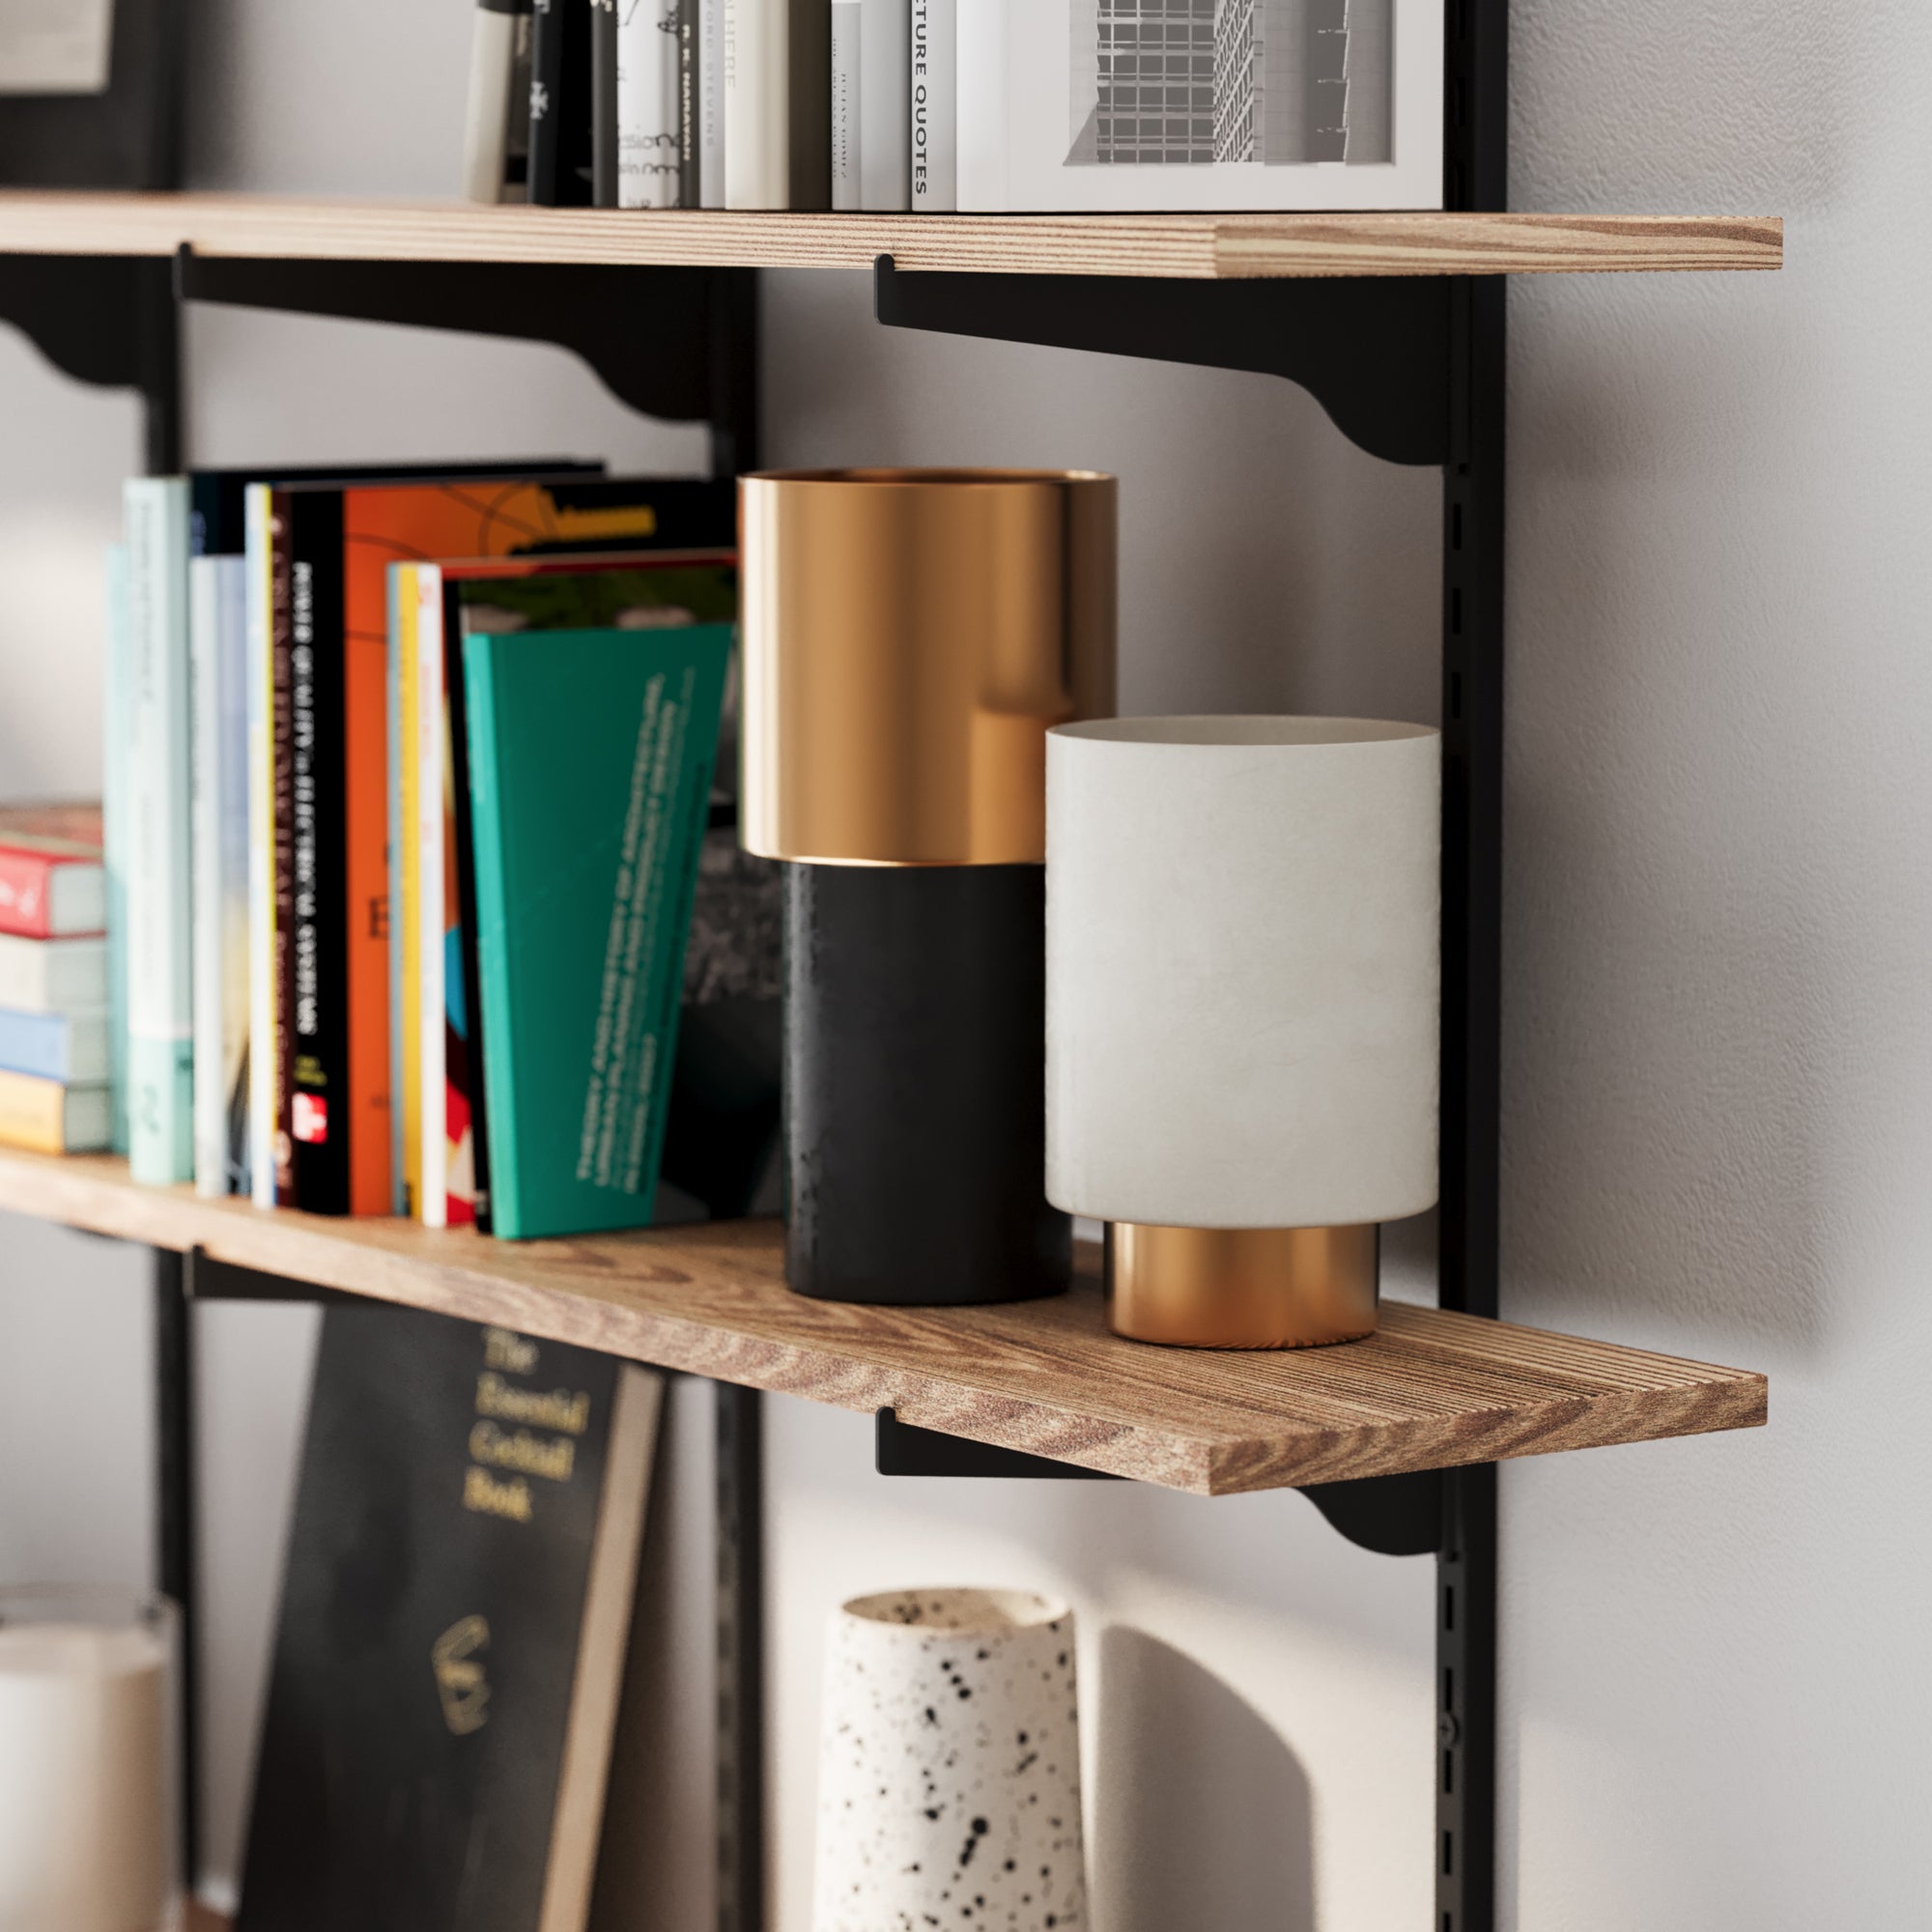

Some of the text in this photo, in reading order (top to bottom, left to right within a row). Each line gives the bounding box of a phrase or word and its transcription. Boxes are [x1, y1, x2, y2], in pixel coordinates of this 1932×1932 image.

[682, 72, 691, 160] NARAYAN
[915, 0, 926, 194] TURE QUOTES
